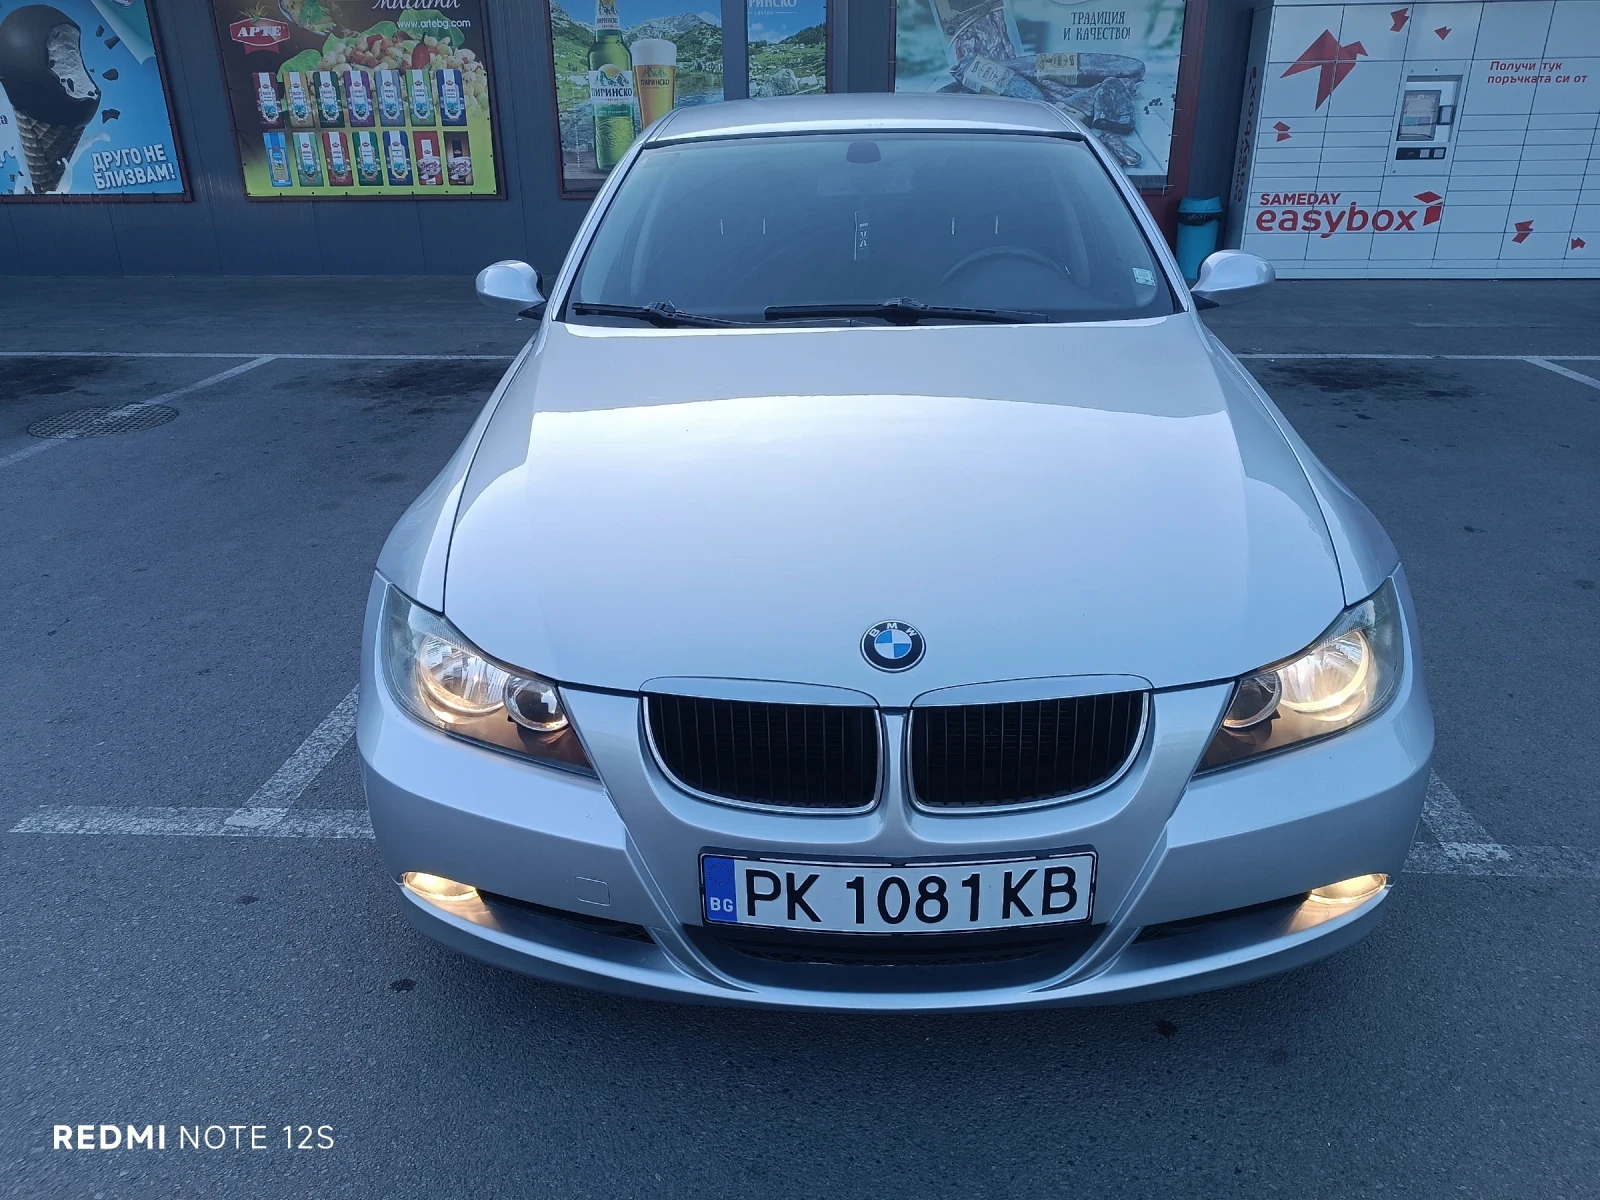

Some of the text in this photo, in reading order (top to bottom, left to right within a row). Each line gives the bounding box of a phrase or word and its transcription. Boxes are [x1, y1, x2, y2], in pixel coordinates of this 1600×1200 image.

[1071, 11, 1126, 26] ТРАДИЦИЯ
[1063, 26, 1131, 40] И КАЧЕСТВО!
[1490, 61, 1563, 72] Получи тук
[1487, 75, 1588, 85] поръчката си от
[91, 144, 167, 173] ДРУГО НЕ
[93, 162, 176, 189] БЛИЗВАМ!
[1260, 192, 1342, 205] SAMEDAY
[1256, 201, 1418, 239] easybox
[868, 622, 918, 638] BMW
[745, 865, 1078, 925] PK 1081 KB
[710, 896, 734, 913] BG
